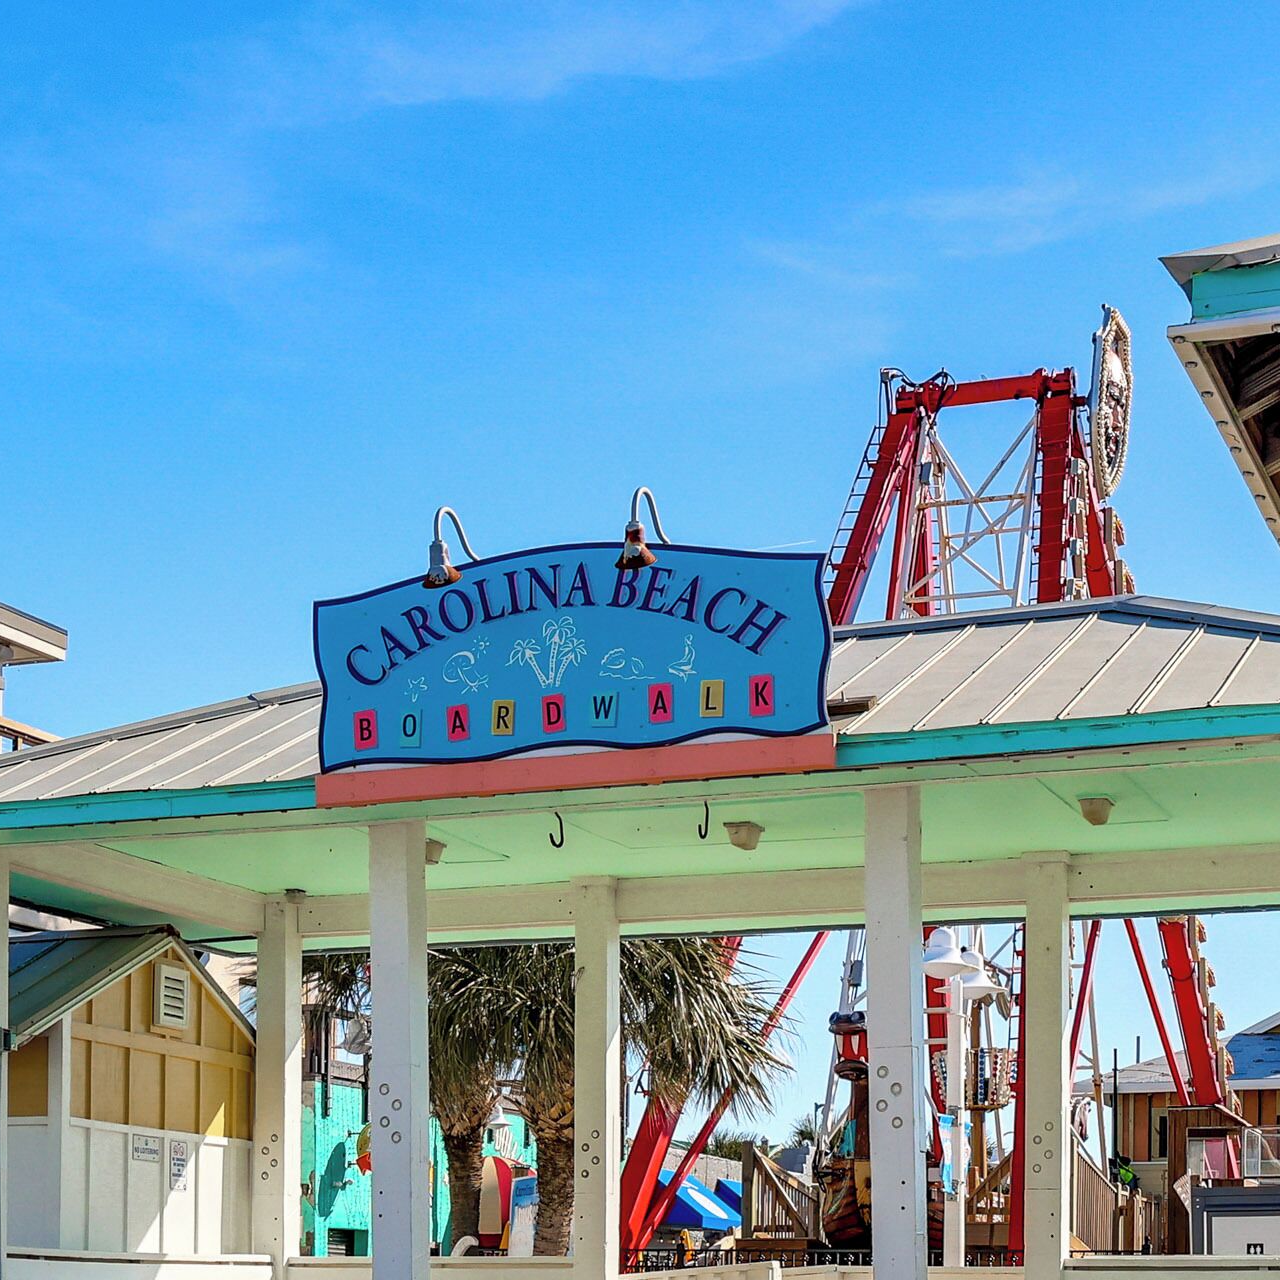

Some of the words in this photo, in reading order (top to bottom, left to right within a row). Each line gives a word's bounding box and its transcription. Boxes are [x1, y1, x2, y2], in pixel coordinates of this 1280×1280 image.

[346, 560, 596, 685] CAROLINA
[607, 566, 790, 655] BEACH
[358, 681, 770, 741] BOARDWALK
